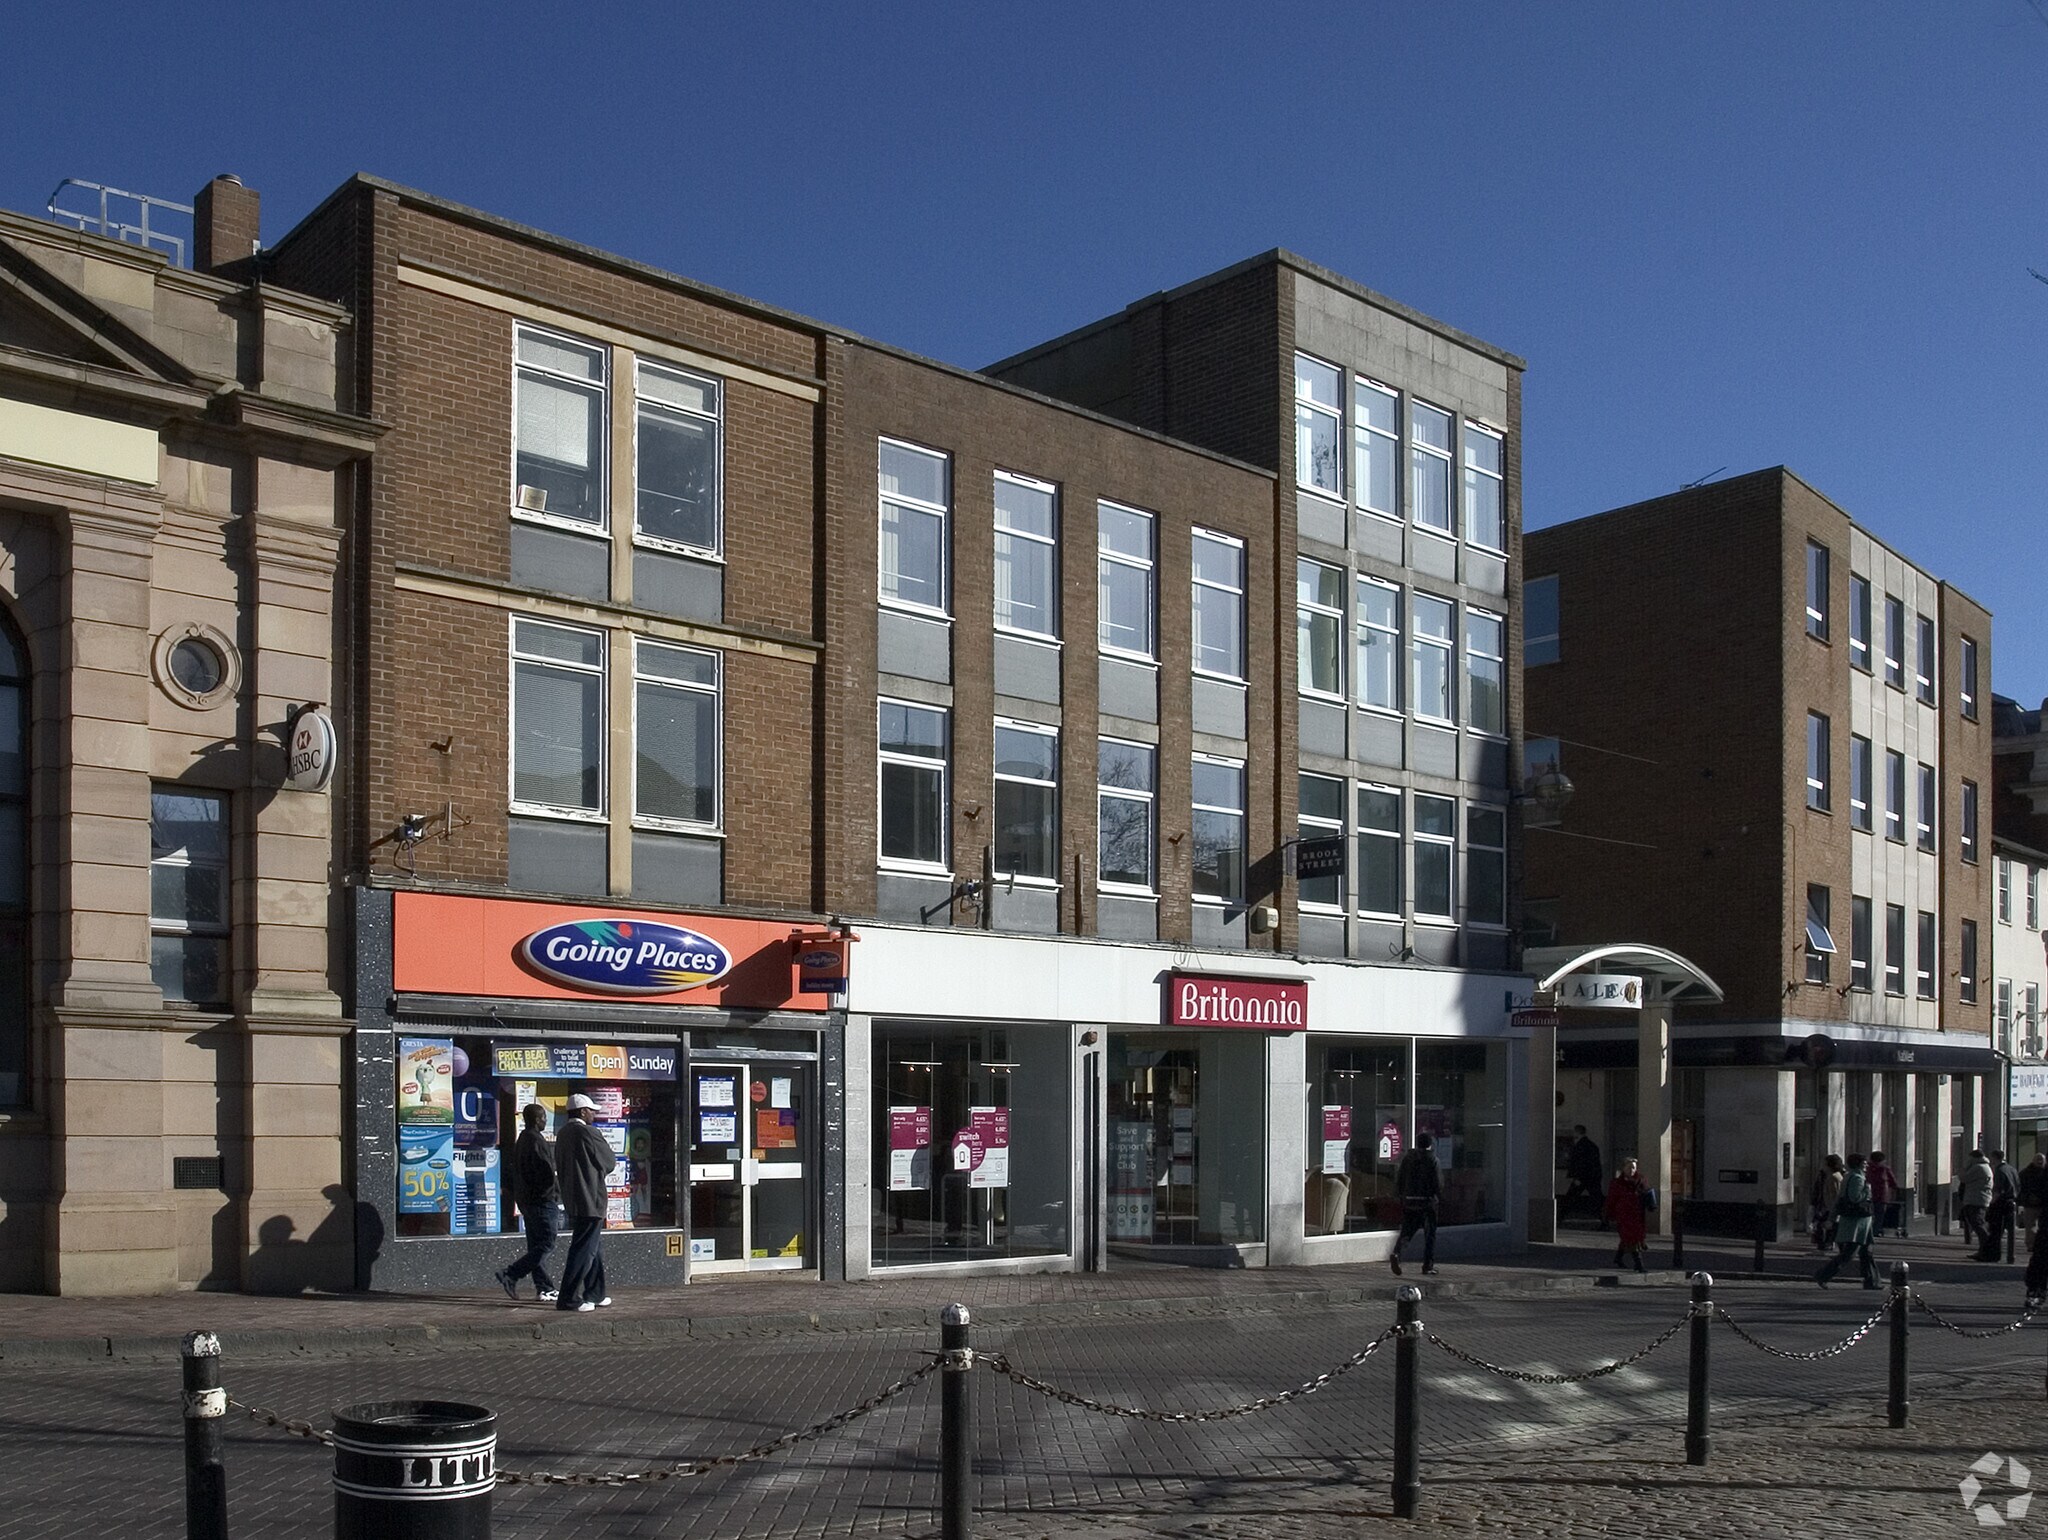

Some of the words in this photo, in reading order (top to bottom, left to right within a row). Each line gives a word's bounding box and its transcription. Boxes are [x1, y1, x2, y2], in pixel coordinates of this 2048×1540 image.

[292, 749, 322, 775] HSBC
[1302, 849, 1338, 860] BROOK
[1298, 858, 1342, 870] STREET
[546, 936, 633, 971] Going
[636, 941, 718, 972] Places
[1179, 983, 1302, 1025] Britannia
[1513, 1015, 1560, 1026] Britannia
[498, 1050, 523, 1061] PRICE
[524, 1050, 547, 1060] BEAT
[553, 1048, 578, 1056] Challenge
[498, 1060, 550, 1071] CHALLENGE
[591, 1054, 622, 1072] Open
[629, 1055, 674, 1074] Sunday
[1116, 1125, 1138, 1135] Save
[959, 1131, 980, 1142] switch
[1108, 1142, 1145, 1153] Support
[453, 1152, 486, 1164] Flights
[1117, 1160, 1137, 1170] Club
[403, 1171, 450, 1196] 50%
